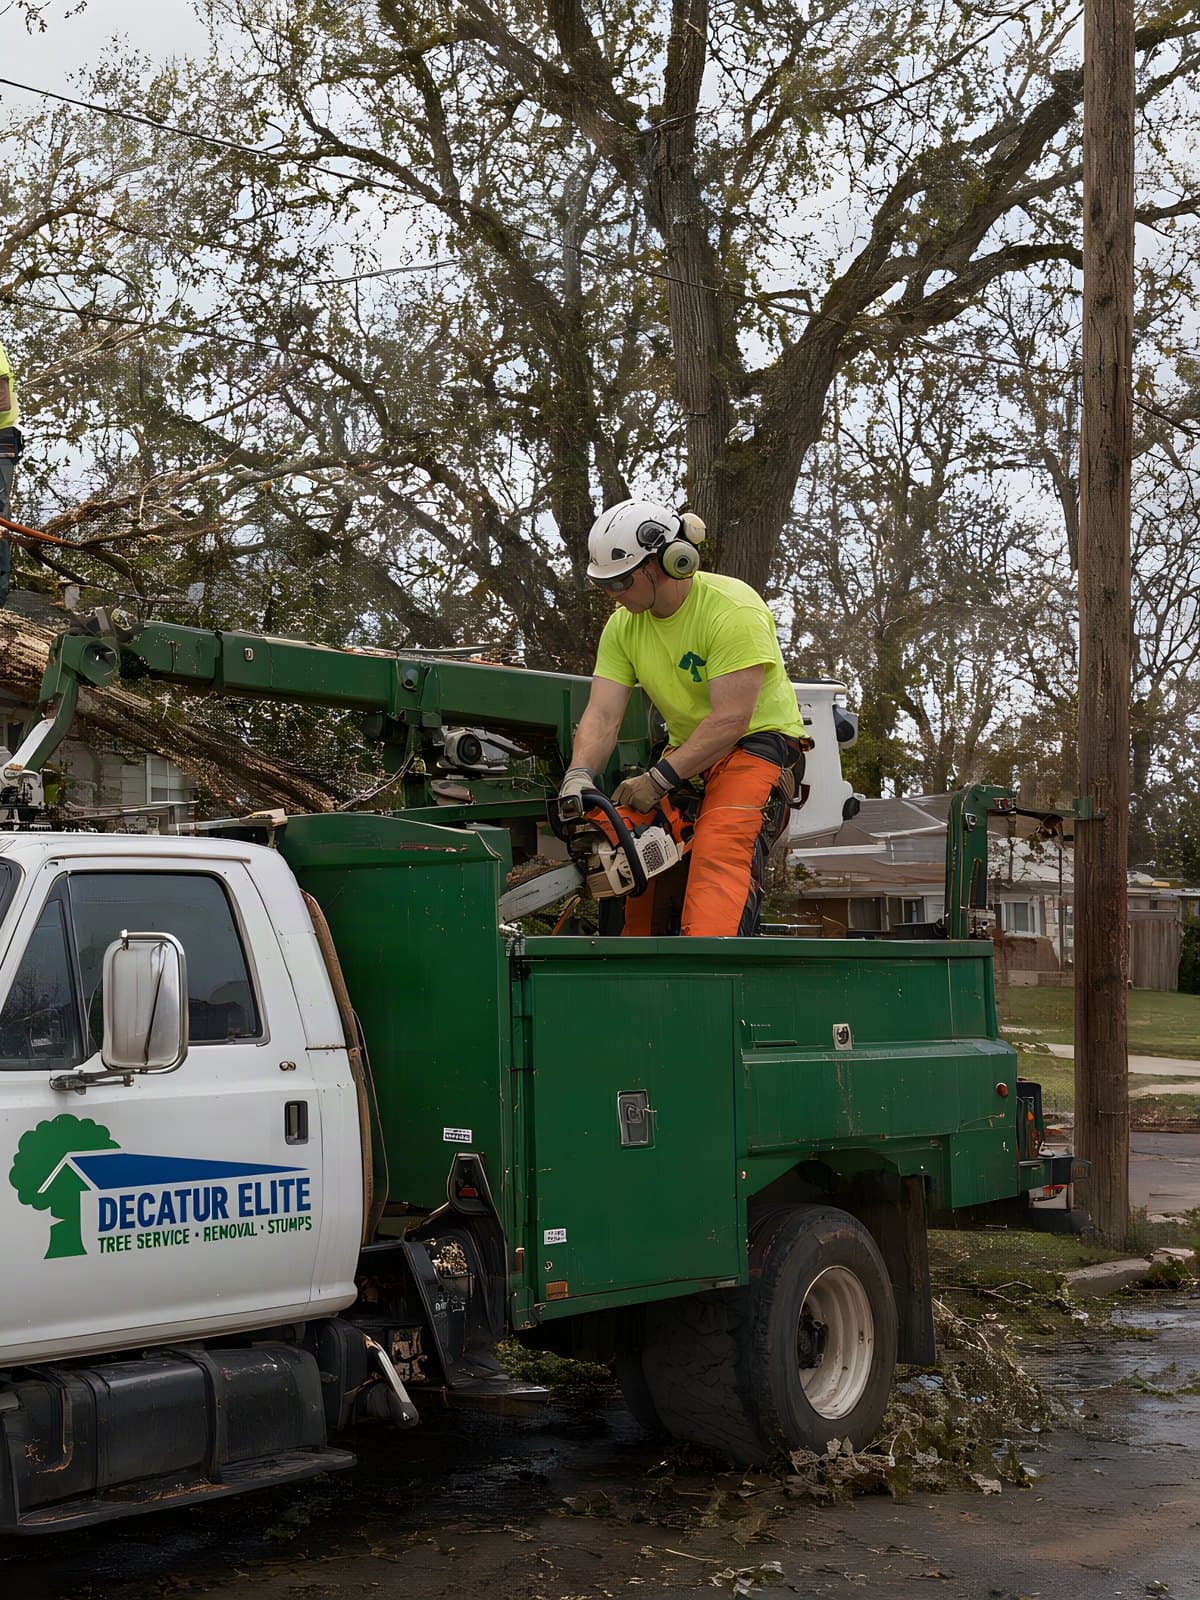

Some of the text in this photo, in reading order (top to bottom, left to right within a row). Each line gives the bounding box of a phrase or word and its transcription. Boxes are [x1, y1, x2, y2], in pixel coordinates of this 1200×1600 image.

[98, 1178, 312, 1232] DECATUR ELITE
[98, 1216, 313, 1254] TREE SERVICE REMOVAL STUMPS
